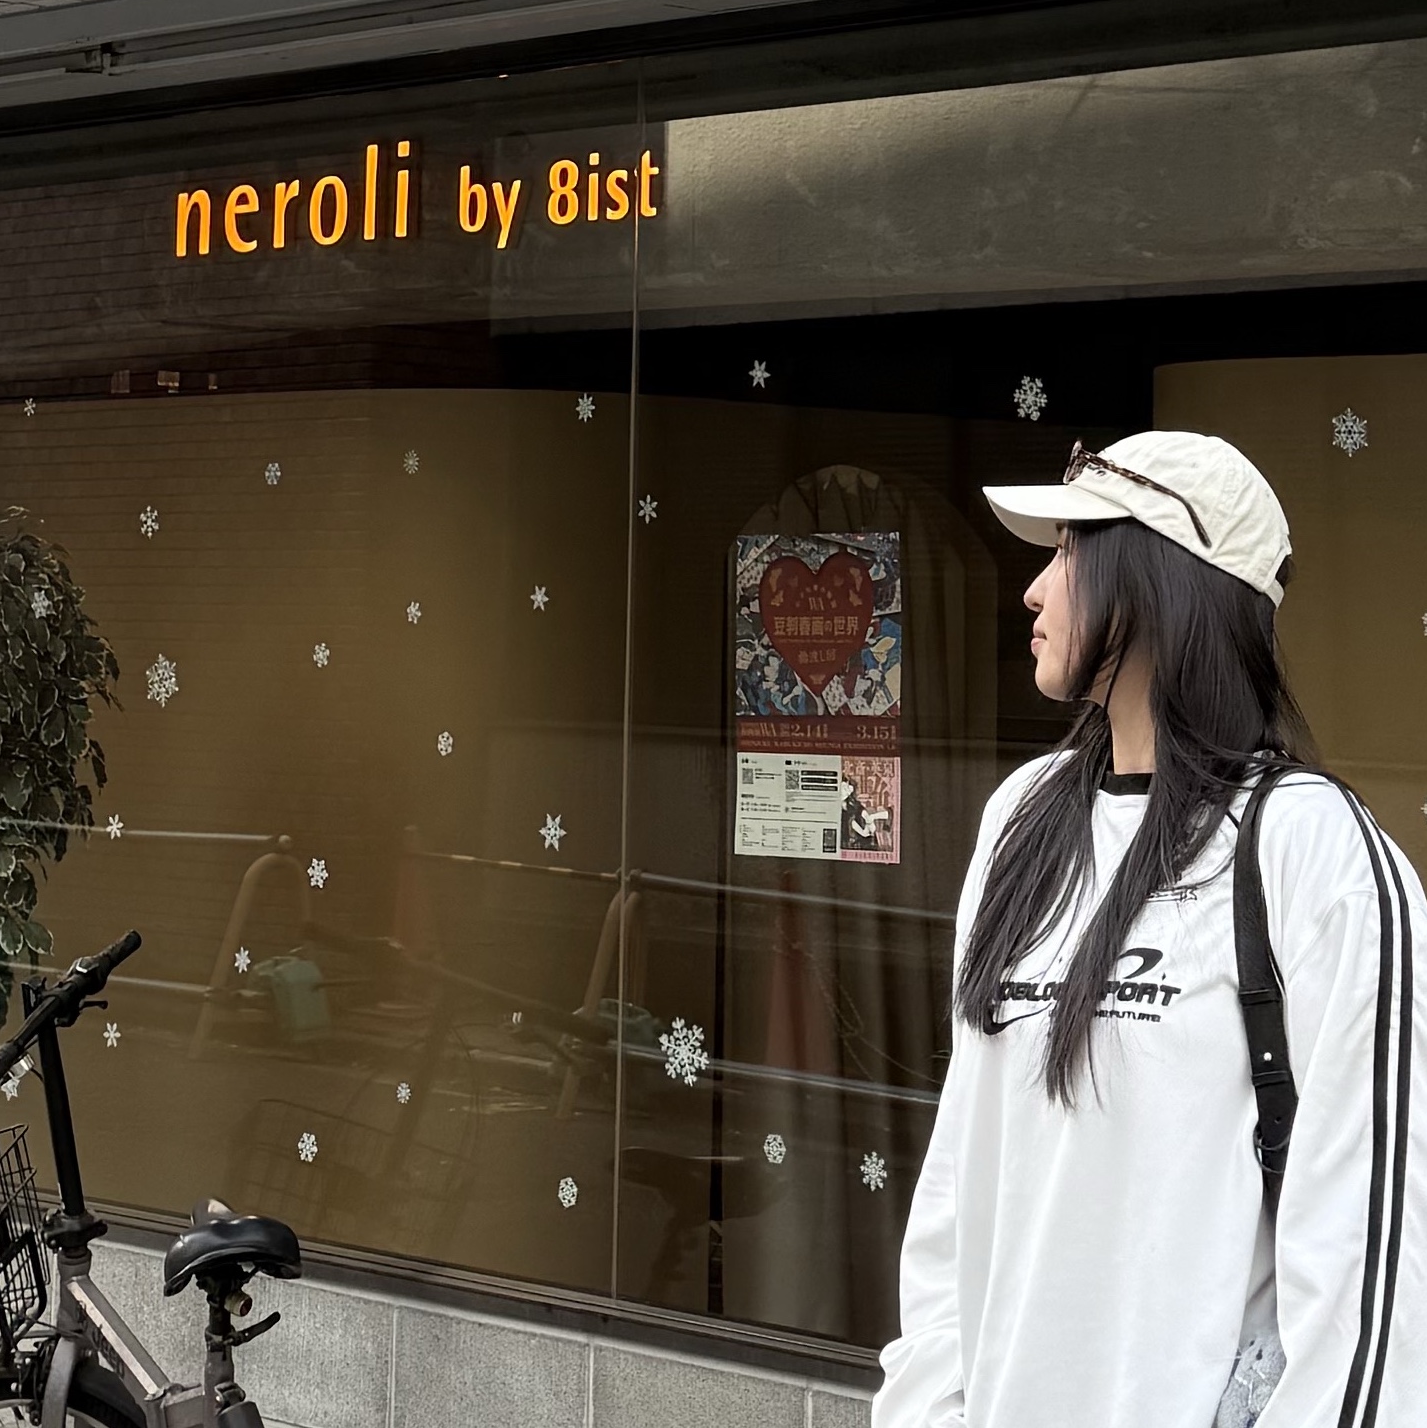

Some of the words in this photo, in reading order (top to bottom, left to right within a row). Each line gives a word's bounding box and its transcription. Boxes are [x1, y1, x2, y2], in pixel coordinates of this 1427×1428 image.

[174, 139, 411, 258] neroli
[458, 164, 522, 250] by
[547, 149, 660, 227] 8ist
[1103, 980, 1182, 1007] PORT
